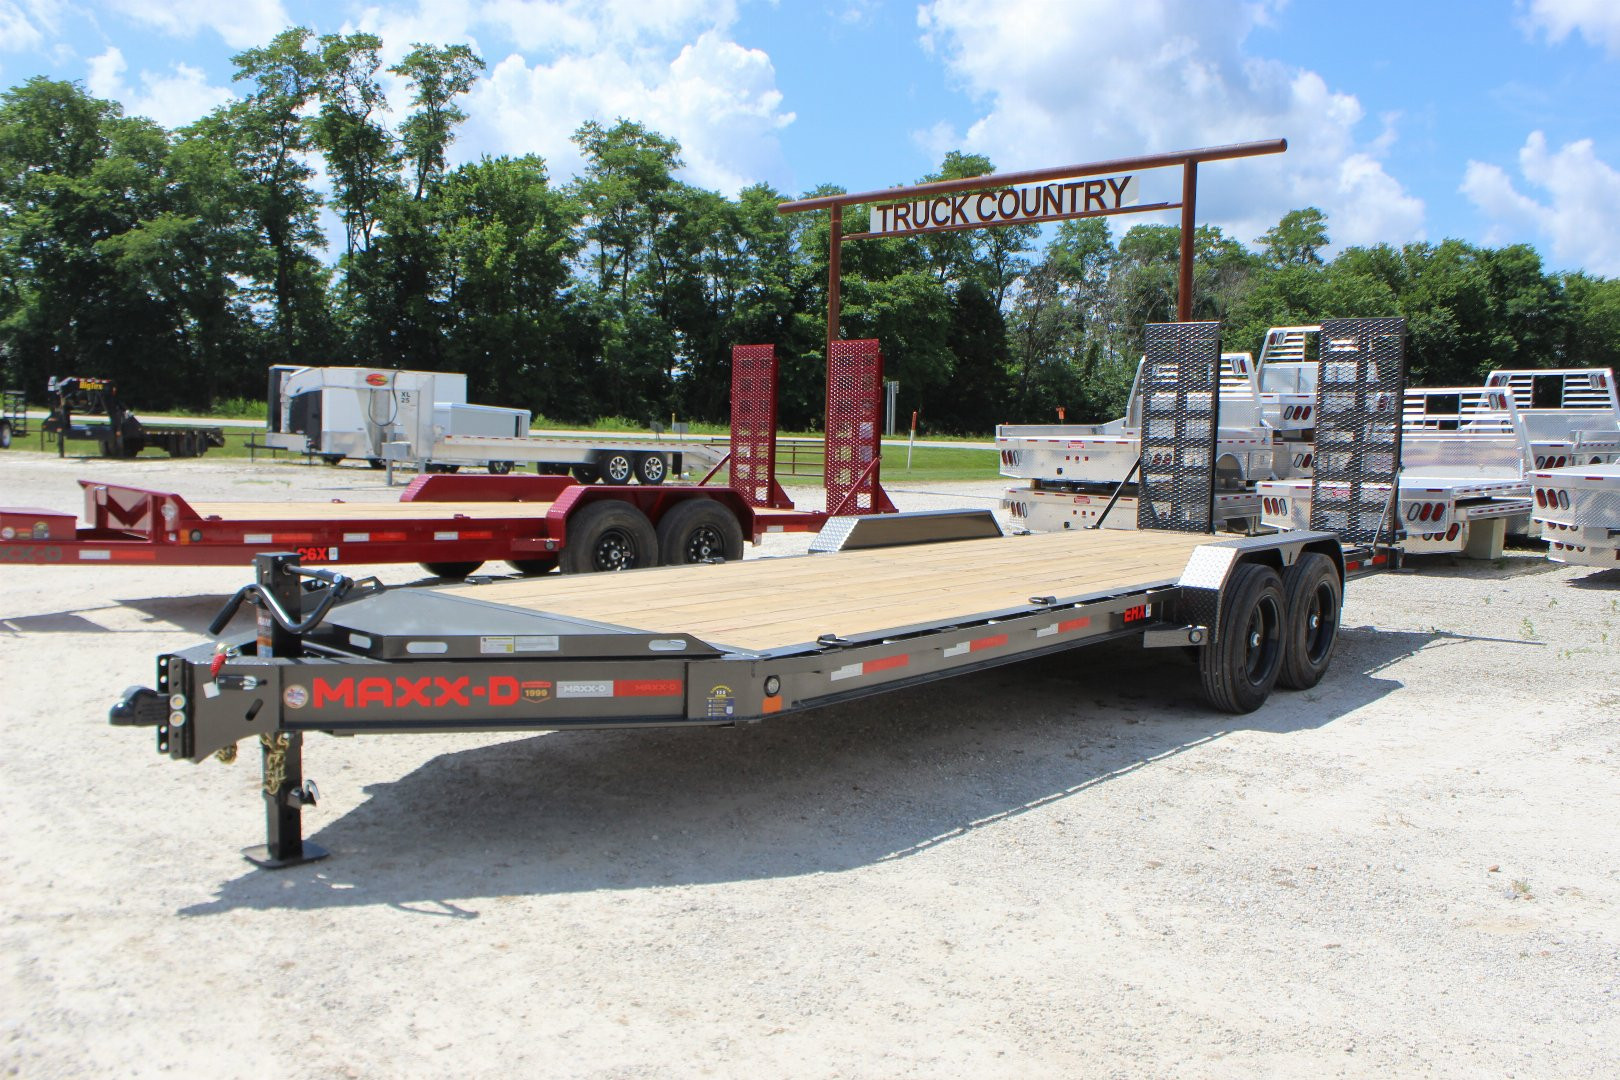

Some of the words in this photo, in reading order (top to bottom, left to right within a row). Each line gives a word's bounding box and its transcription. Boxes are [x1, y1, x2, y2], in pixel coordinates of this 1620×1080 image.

[876, 194, 971, 232] TRUCK
[976, 175, 1133, 222] COUNTRY
[296, 547, 328, 561] C6X
[312, 676, 520, 708] MAXX-D
[524, 688, 548, 697] 1999
[563, 684, 606, 693] MAXX-D
